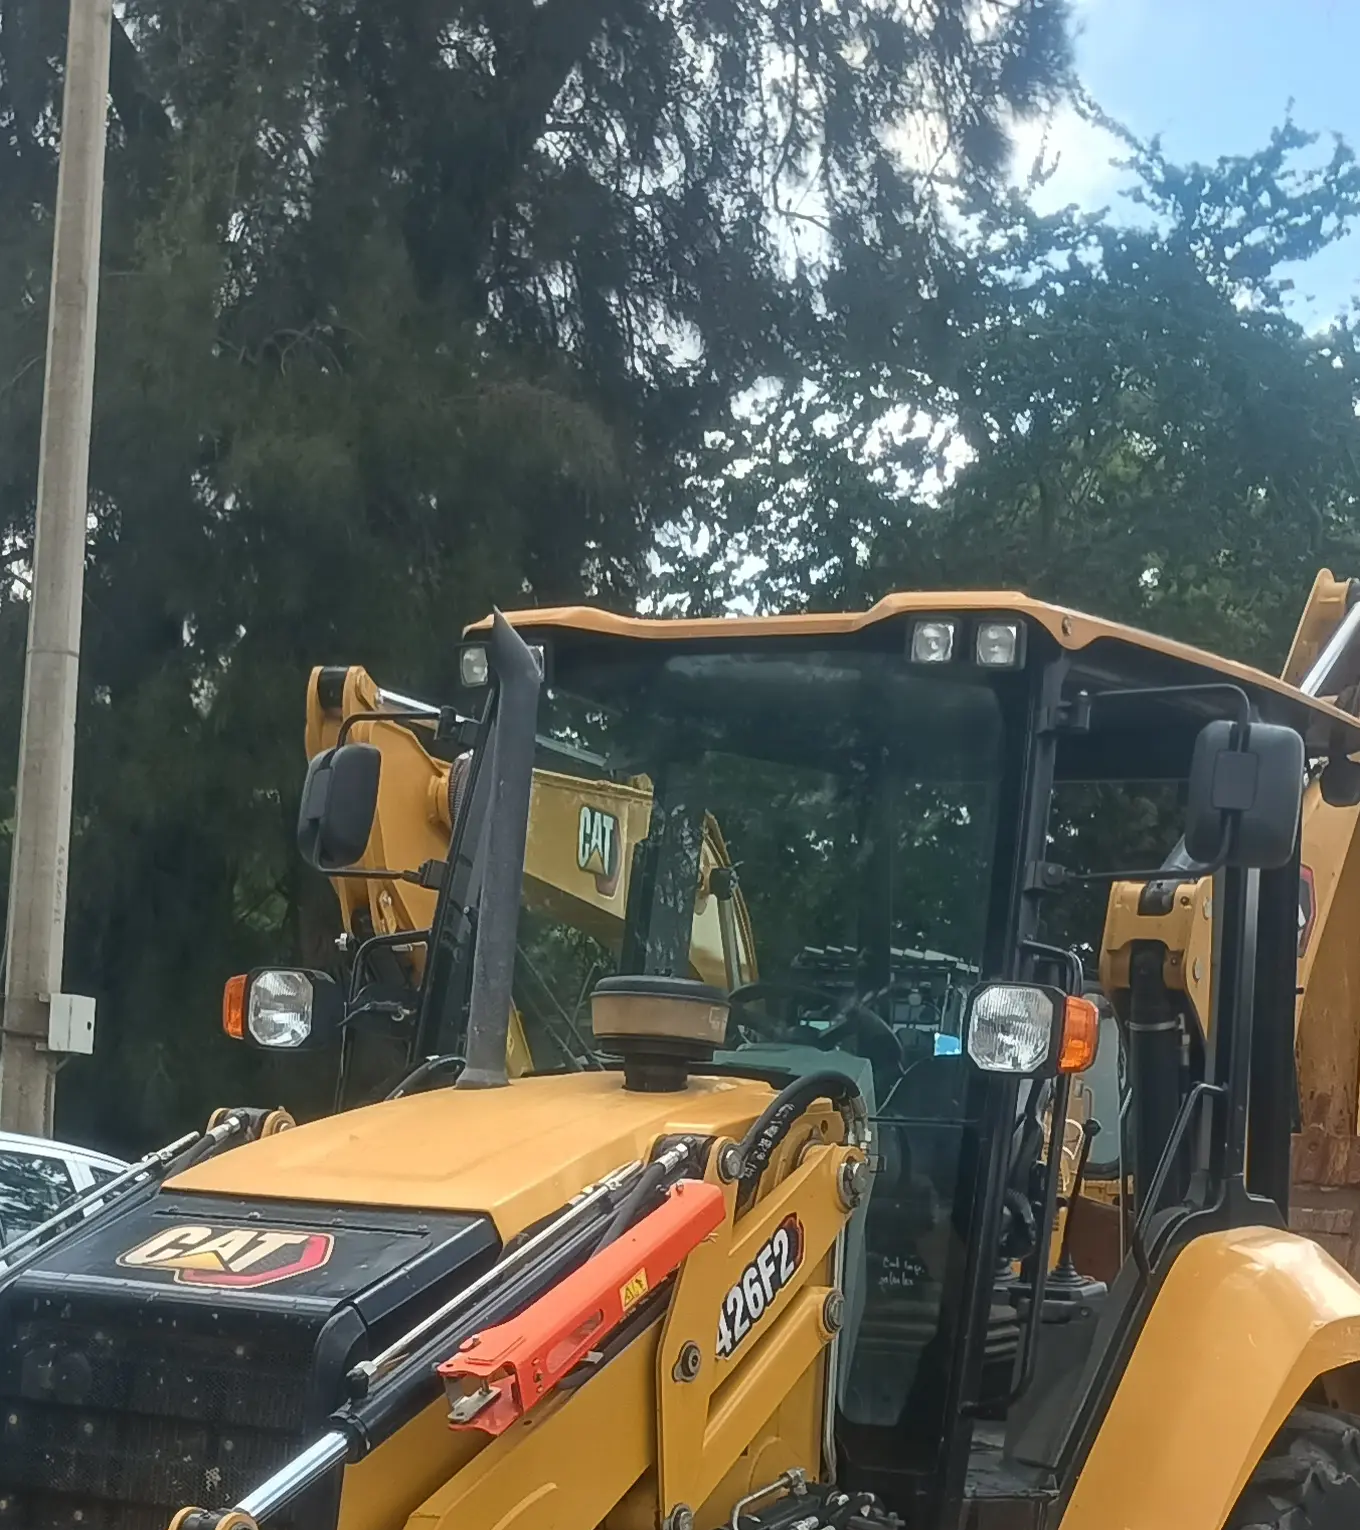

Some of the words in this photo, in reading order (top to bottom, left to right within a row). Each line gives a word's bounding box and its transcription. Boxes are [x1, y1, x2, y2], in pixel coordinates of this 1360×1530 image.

[577, 805, 615, 877] CAT
[123, 1225, 311, 1273] CAT
[715, 1228, 795, 1356] 426F2
